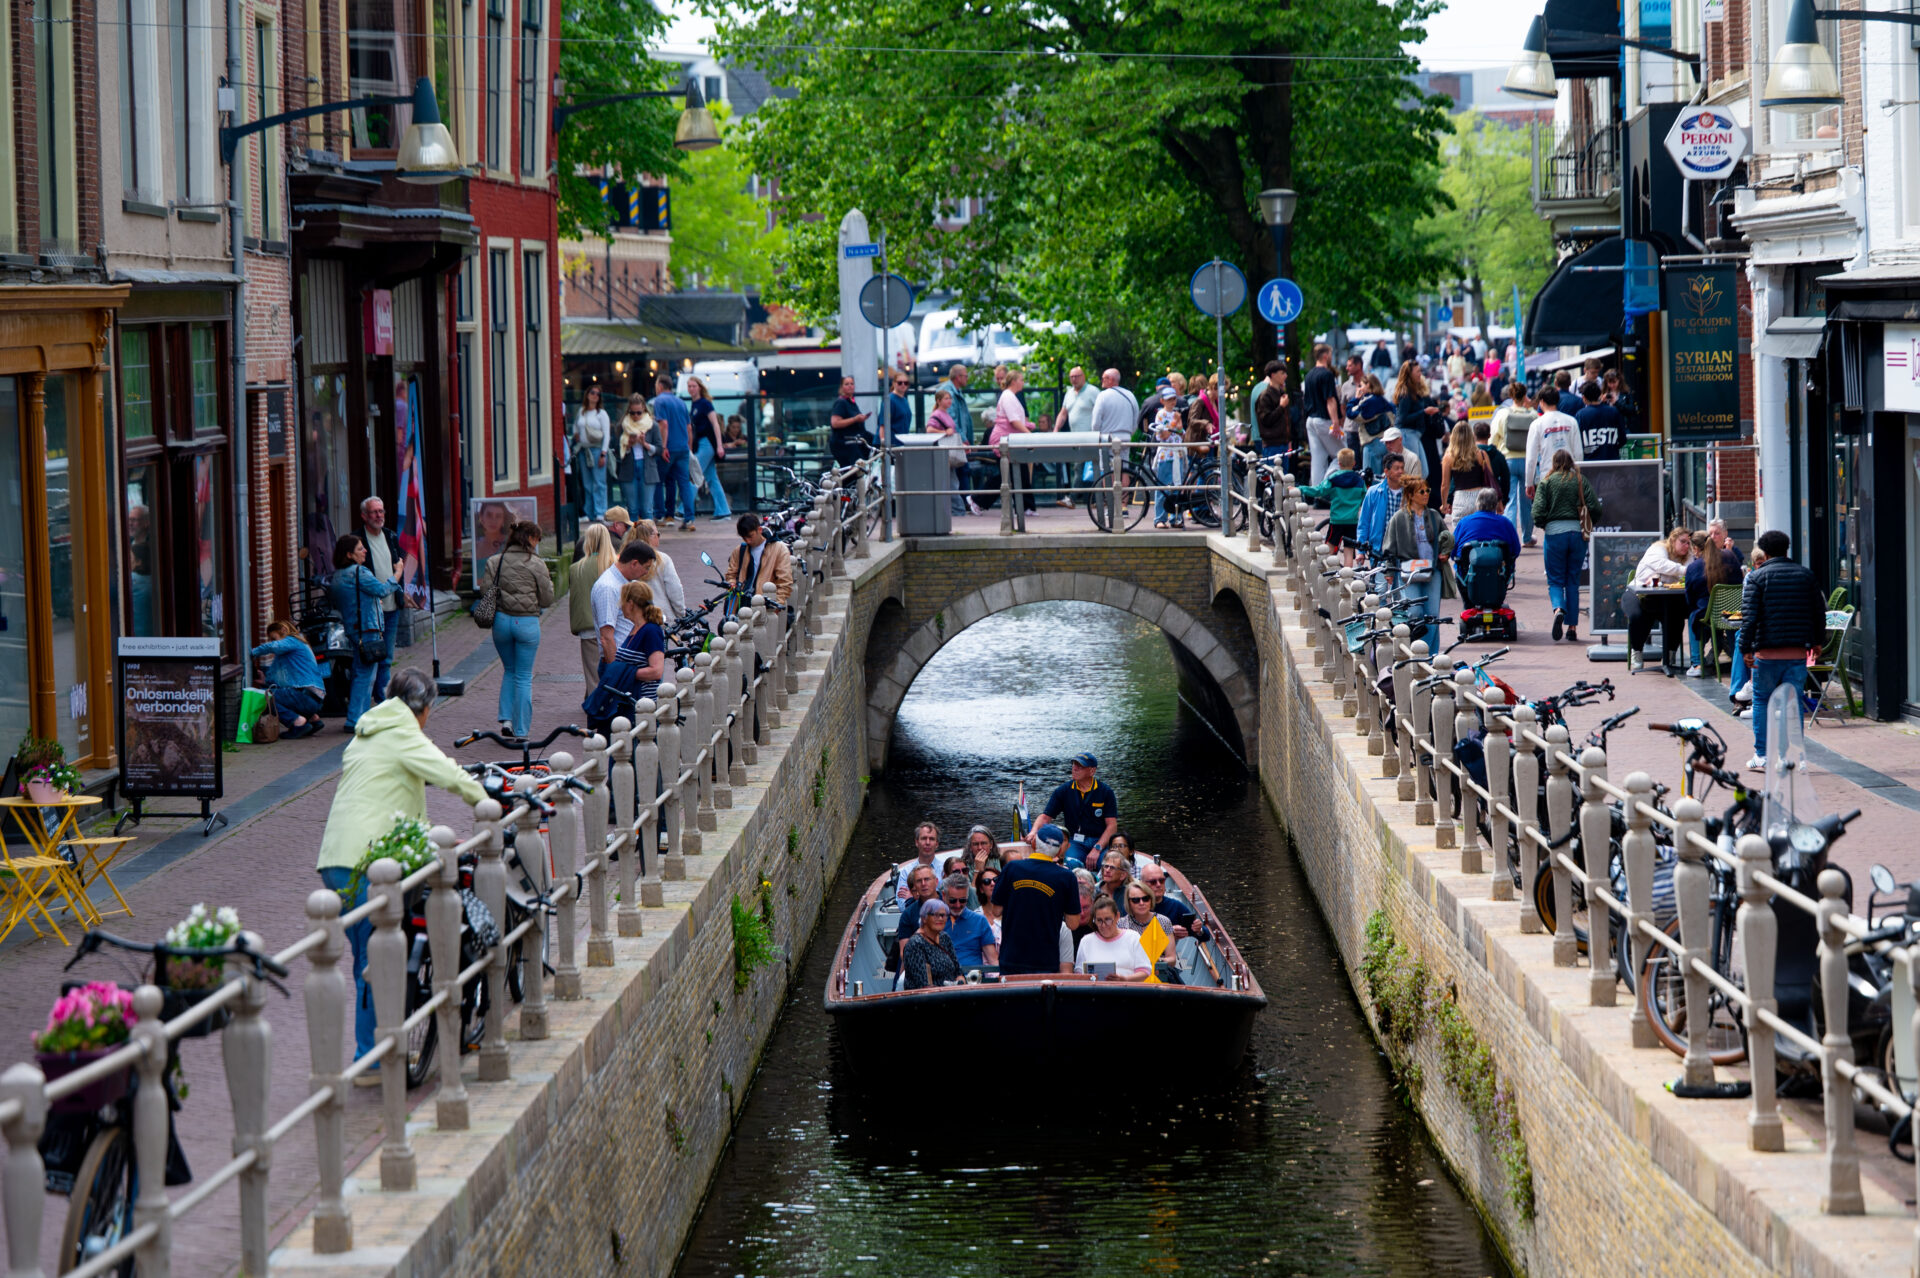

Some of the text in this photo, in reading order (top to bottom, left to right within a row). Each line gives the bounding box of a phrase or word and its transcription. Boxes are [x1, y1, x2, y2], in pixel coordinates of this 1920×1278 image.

[1681, 132, 1733, 145] PERONI
[1673, 316, 1732, 328] DE GOUDEN
[1675, 350, 1733, 365] SYRIAN
[1675, 364, 1733, 374] RESTAURANT
[1675, 373, 1733, 383] LUNCHROOM
[1677, 411, 1734, 424] Welcome
[175, 643, 188, 651] just
[126, 687, 214, 703] Onlosmakelijk
[135, 701, 206, 713] verbonden
